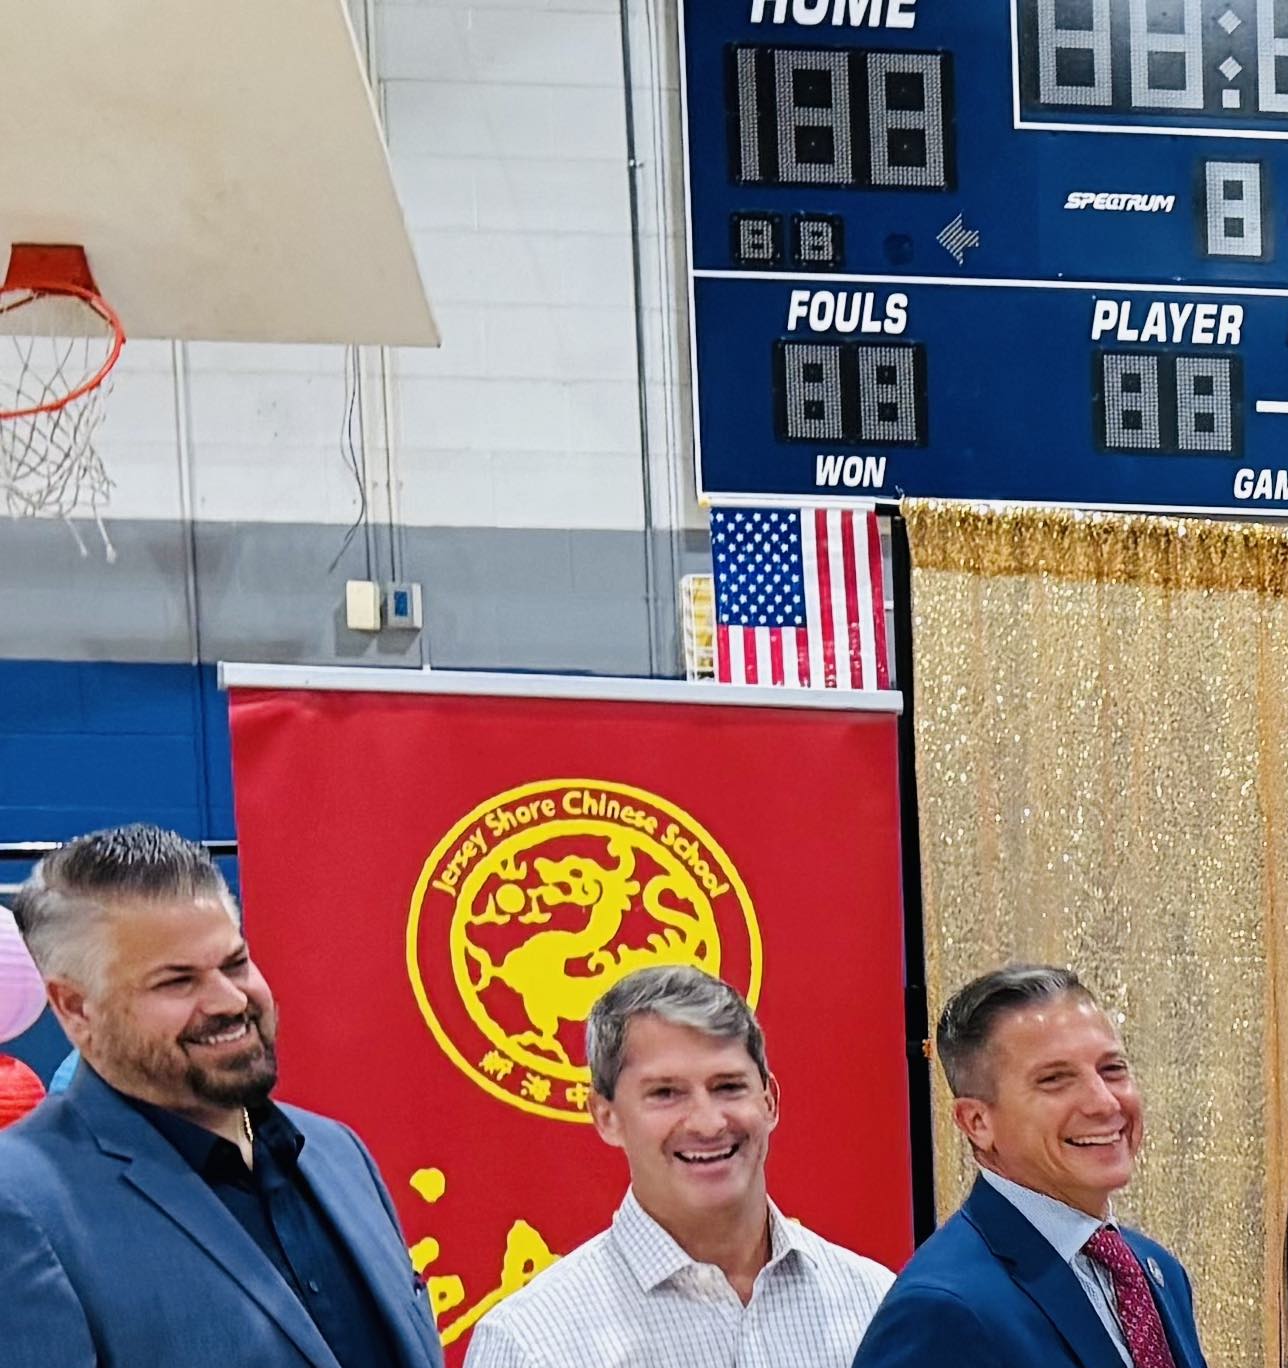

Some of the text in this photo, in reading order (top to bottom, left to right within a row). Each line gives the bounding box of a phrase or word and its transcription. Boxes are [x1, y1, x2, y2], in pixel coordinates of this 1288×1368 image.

[1063, 191, 1176, 213] SPECTRUM
[787, 289, 908, 334] FOULS
[1091, 300, 1244, 345] PLAYER
[815, 454, 887, 488] WON
[432, 790, 730, 898] Jersey Shore Chinese School
